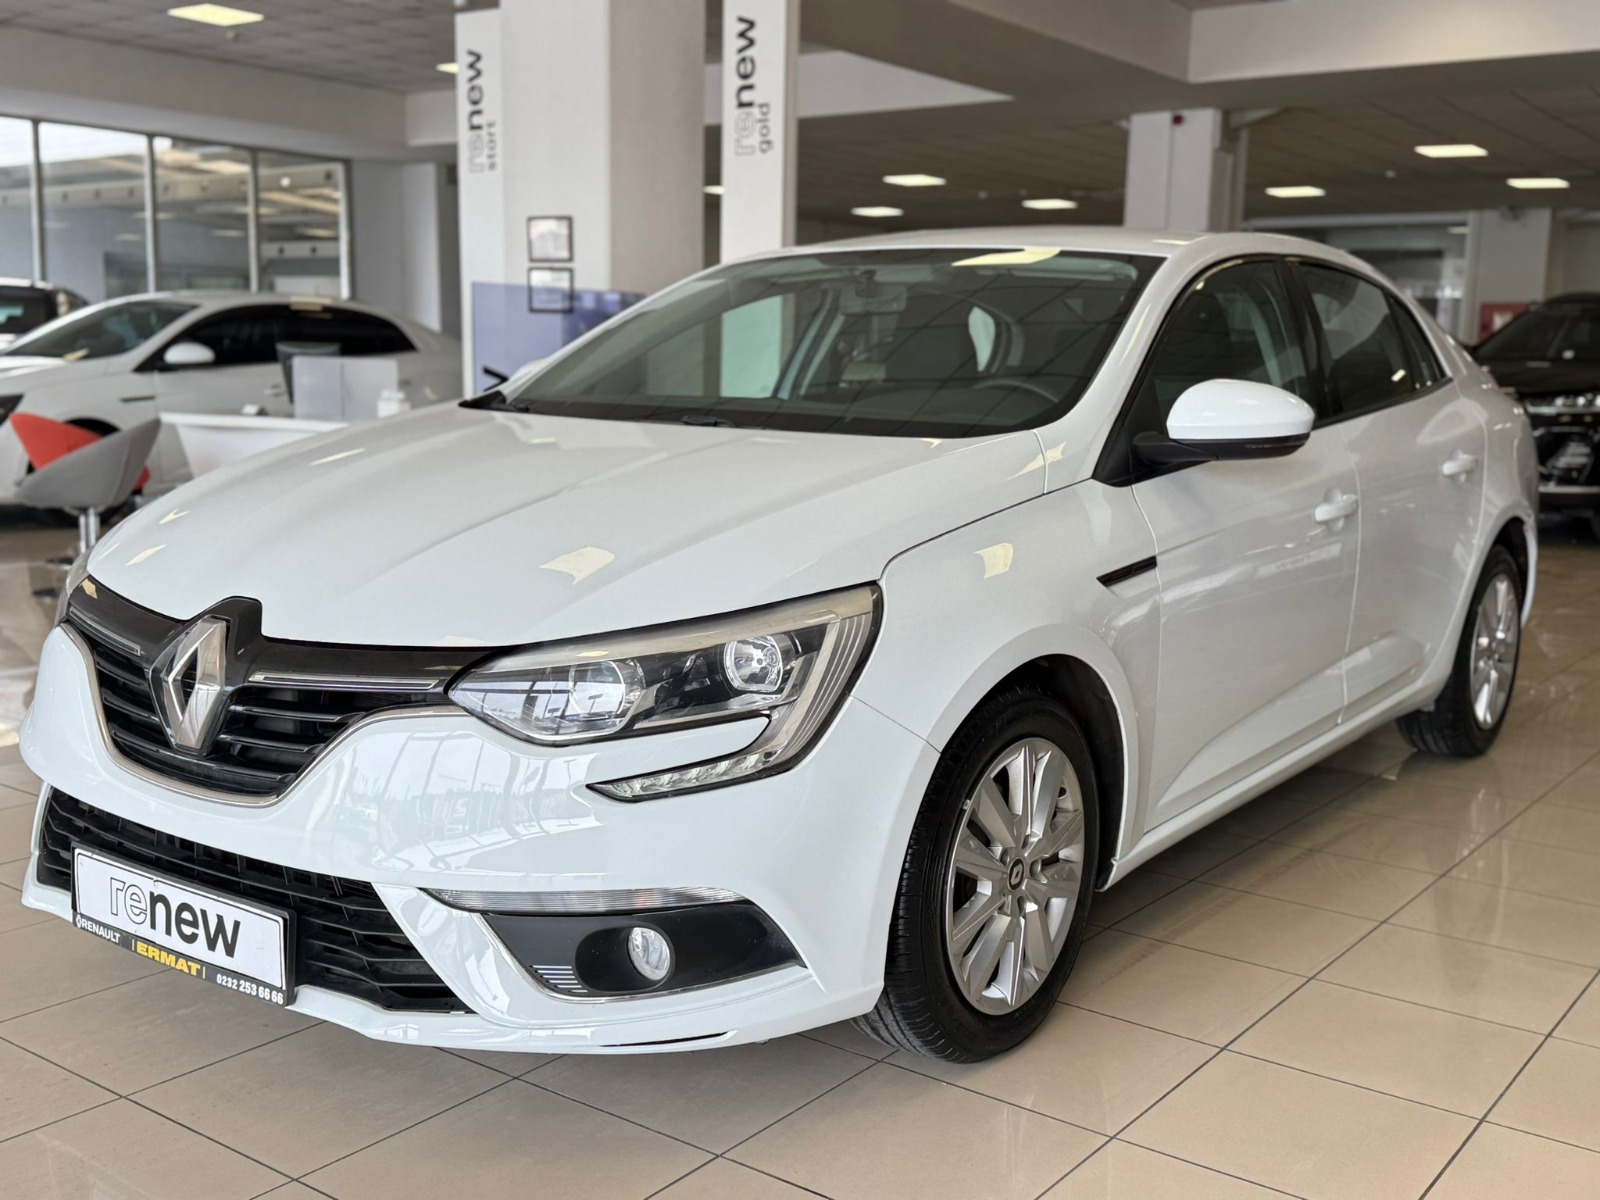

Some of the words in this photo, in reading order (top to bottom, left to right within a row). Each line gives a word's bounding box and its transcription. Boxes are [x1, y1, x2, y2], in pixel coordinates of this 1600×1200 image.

[466, 49, 485, 173] renew
[733, 16, 756, 156] renew
[486, 120, 497, 172] start
[756, 102, 773, 154] gold
[81, 918, 121, 944] RENAULT
[110, 876, 241, 959] renew
[136, 940, 201, 976] ERMAT
[216, 973, 238, 990] 0232
[239, 980, 257, 996] 253
